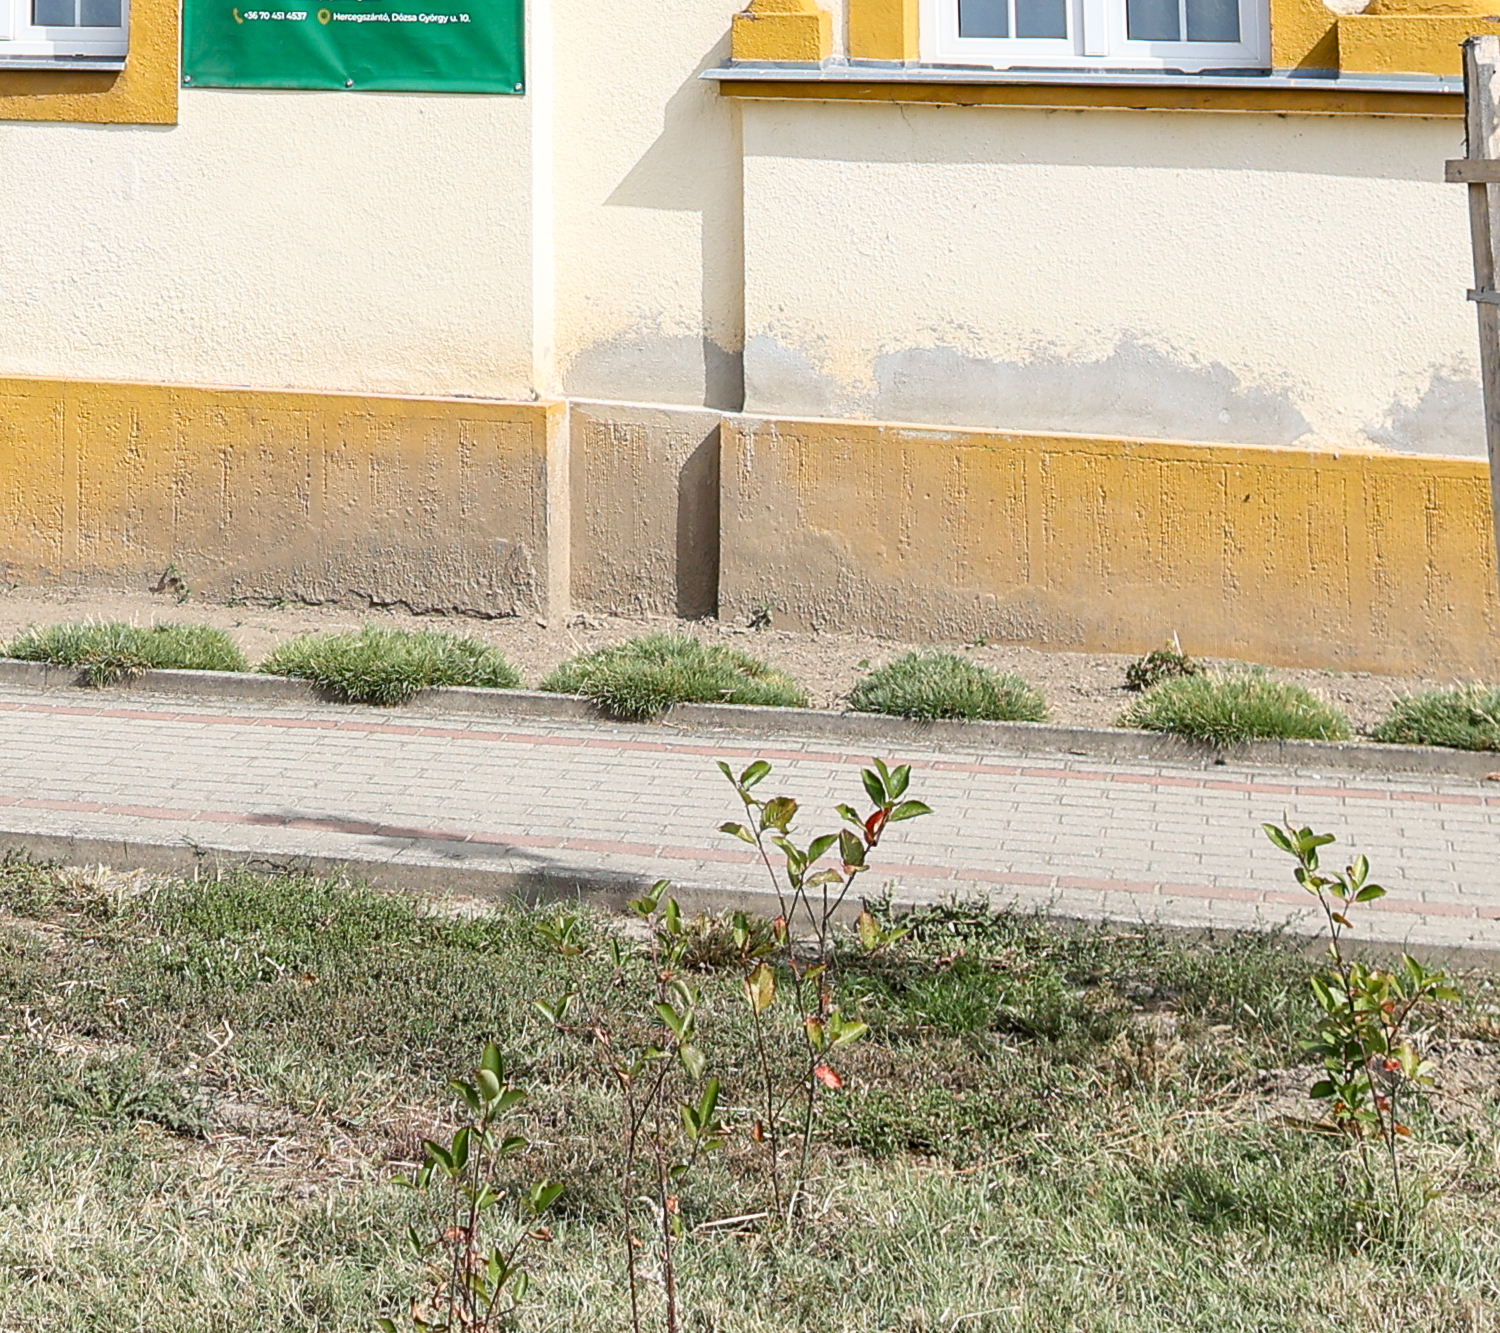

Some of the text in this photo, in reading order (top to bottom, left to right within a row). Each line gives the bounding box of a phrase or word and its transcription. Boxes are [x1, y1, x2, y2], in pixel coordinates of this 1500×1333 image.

[243, 11, 308, 20] +36 70 451 4537
[333, 12, 390, 23] Hercegszántó,
[392, 13, 417, 22] Dózsa
[418, 13, 448, 24] György
[459, 14, 471, 22] 10.
